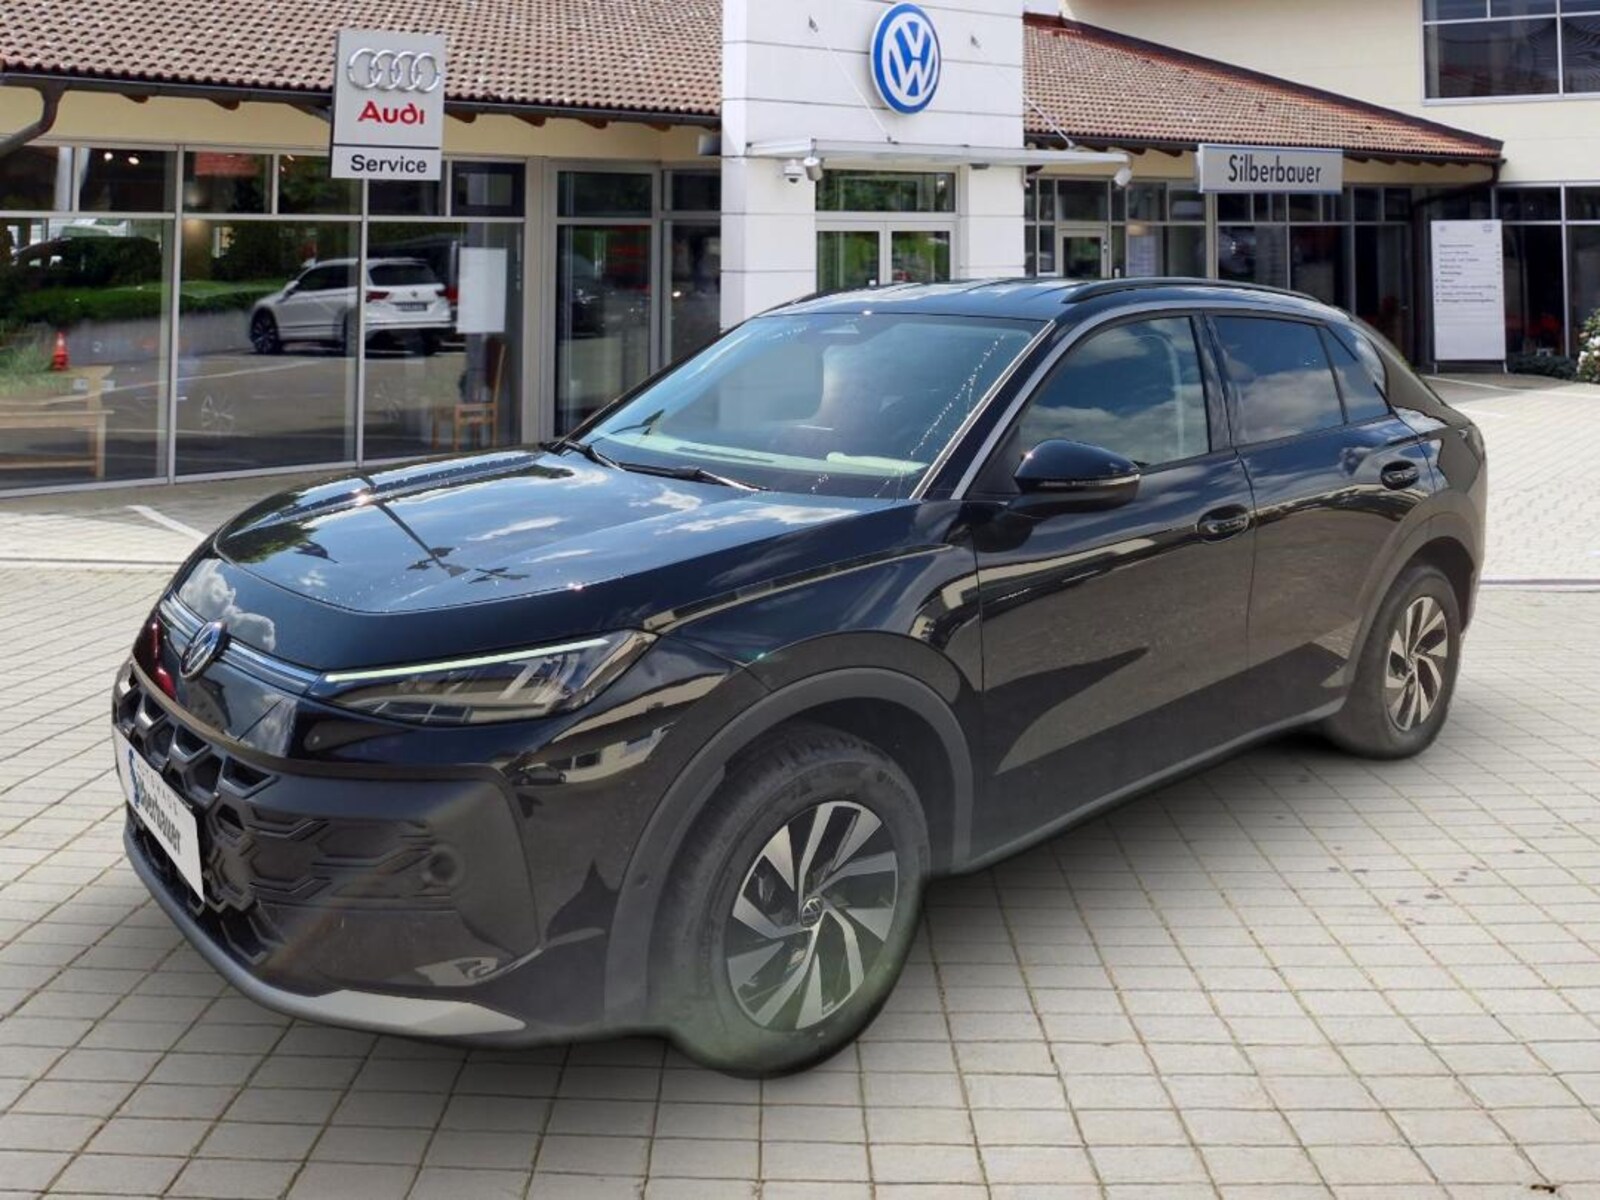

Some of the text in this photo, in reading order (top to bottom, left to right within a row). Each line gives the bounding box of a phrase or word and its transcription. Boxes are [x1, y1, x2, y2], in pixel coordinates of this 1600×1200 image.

[882, 12, 939, 106] VW
[357, 101, 425, 125] Audi
[351, 154, 427, 173] Service
[1228, 154, 1321, 183] Silberbauer
